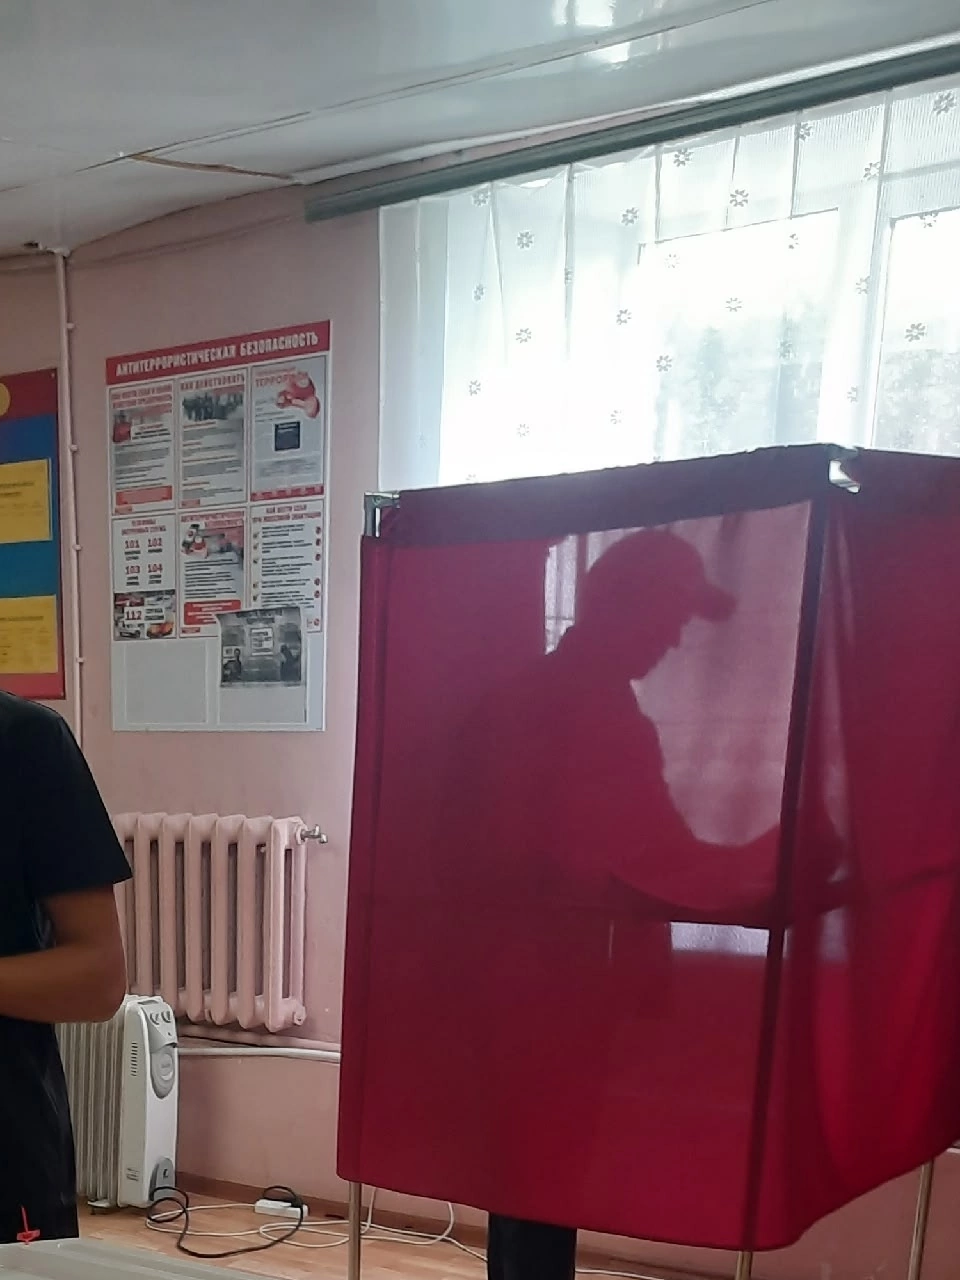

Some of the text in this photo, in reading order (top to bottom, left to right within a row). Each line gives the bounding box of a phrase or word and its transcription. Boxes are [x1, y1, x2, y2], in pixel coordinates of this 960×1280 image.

[116, 331, 319, 376] АНТИТЕРРОРИСТИЧЕСКАЯ БЕЗОПАСНОСТЬ
[125, 610, 142, 621] 112
